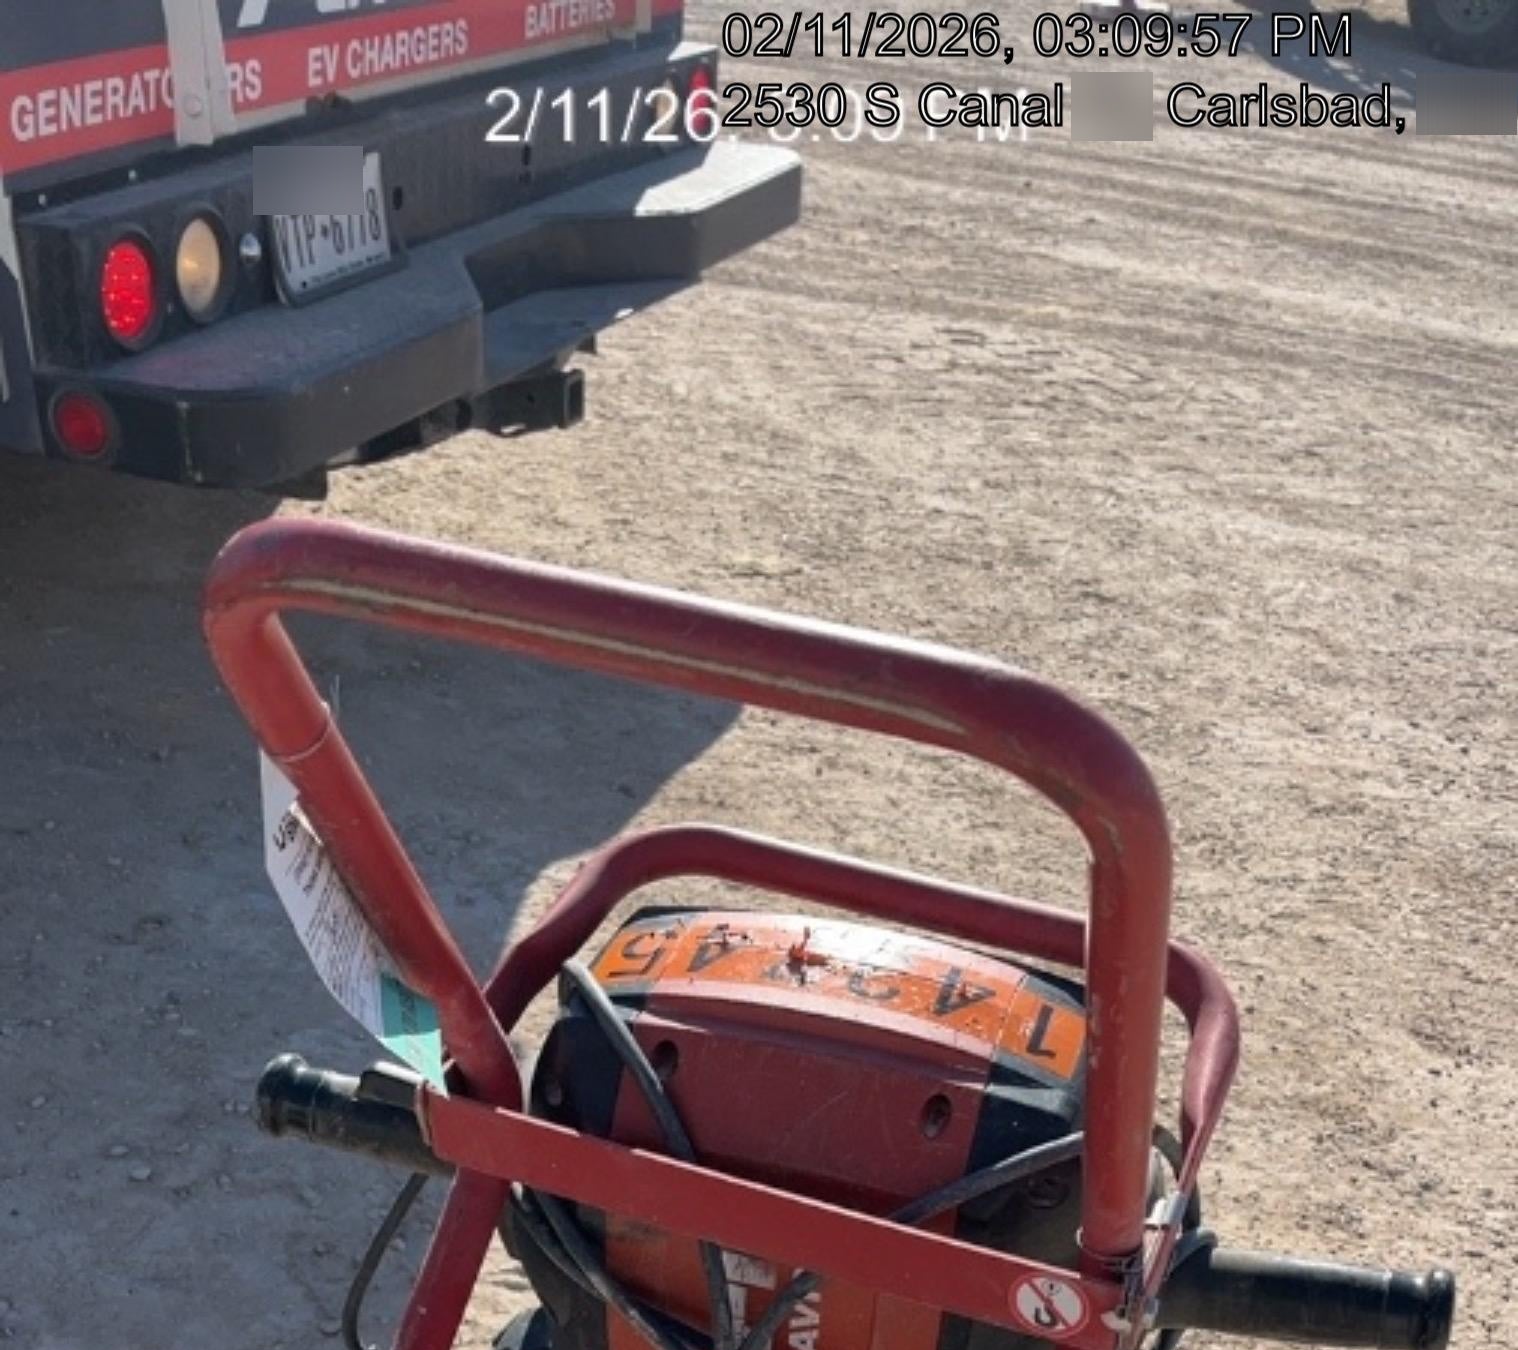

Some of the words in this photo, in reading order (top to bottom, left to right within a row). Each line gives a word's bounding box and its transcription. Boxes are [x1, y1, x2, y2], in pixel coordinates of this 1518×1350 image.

[308, 44, 340, 87] EV
[346, 18, 469, 79] CHARGERS
[525, 0, 616, 40] BATTERIES
[607, 922, 1058, 1059] 1445
